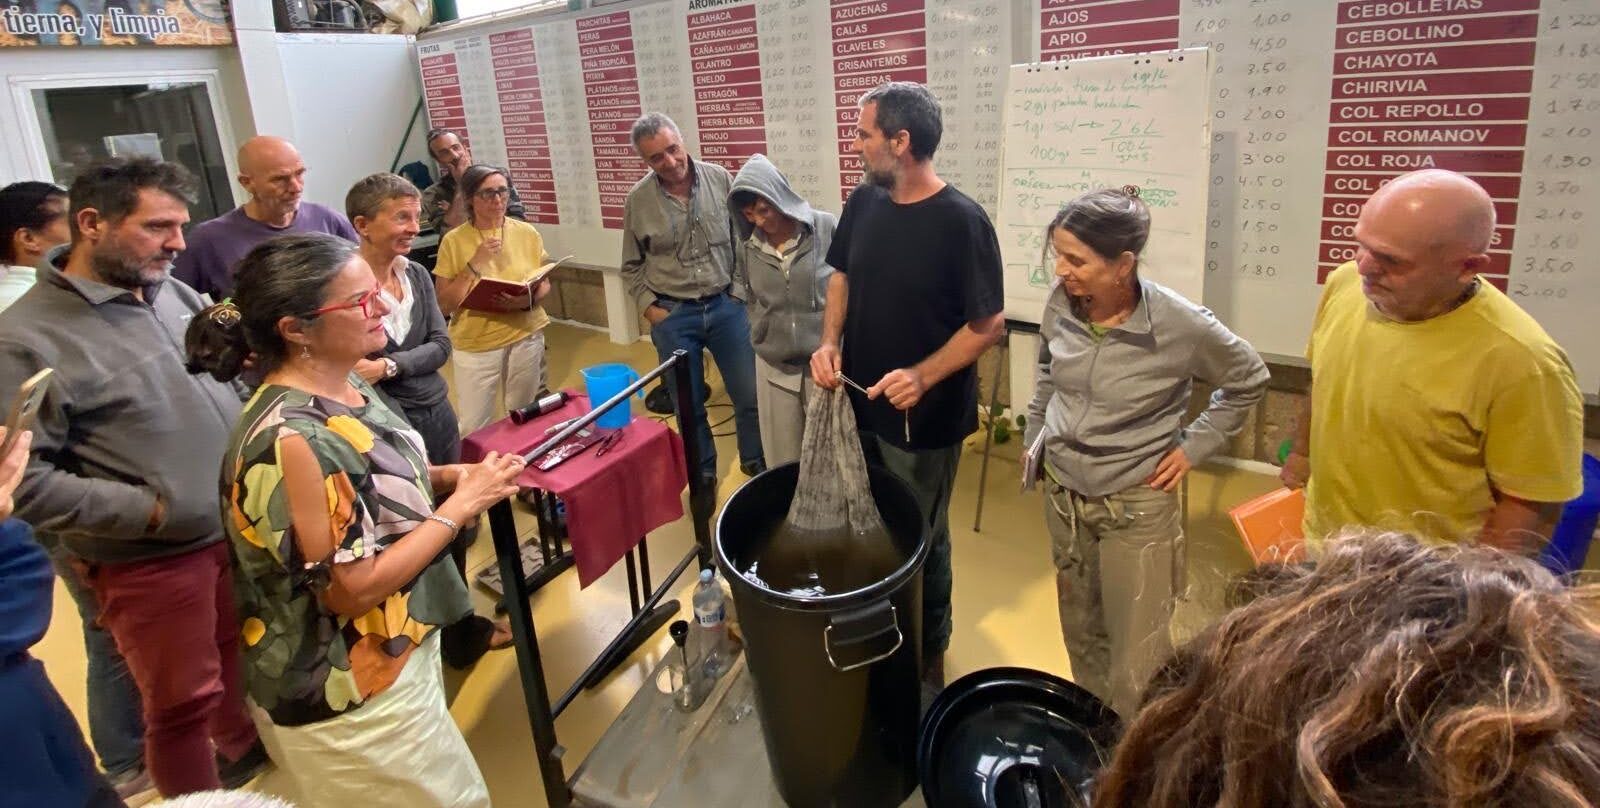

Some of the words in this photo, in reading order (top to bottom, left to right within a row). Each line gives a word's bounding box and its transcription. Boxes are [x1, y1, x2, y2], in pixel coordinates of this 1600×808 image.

[835, 3, 888, 19] AZUCENAS
[1347, 0, 1484, 20] CEBOLLETAS
[3, 5, 86, 36] tierna,
[89, 14, 103, 40] y
[109, 7, 182, 40] limpia
[578, 17, 611, 27] PARCHITAS
[690, 11, 732, 25] ALBAHACA
[1048, 10, 1089, 26] AJOS
[692, 28, 727, 41] AZAFRÁN
[726, 26, 754, 37] CANARIO
[835, 23, 868, 36] CALAS
[1345, 23, 1465, 45] CEBOLLINO
[580, 32, 600, 41] PERAS
[1048, 31, 1087, 47] APIO
[420, 44, 440, 54] FRUTAS
[582, 47, 598, 55] PERA
[598, 43, 620, 53] MELÓN
[693, 44, 714, 56] CAÑA
[836, 39, 886, 54] CLAVELES
[598, 57, 628, 67] TROPICAL
[695, 58, 732, 70] CILANTRO
[838, 54, 908, 71] CRISANTEMOS
[1343, 51, 1439, 71] CHAYOTA
[696, 74, 726, 85] ENELDO
[839, 74, 892, 88] GERBERAS
[587, 85, 618, 94] PLÁTANOS
[1341, 78, 1428, 95] CHIRIVIA
[698, 88, 738, 100] ESTRAGÓN
[589, 98, 620, 107] PLÁTANOS
[699, 103, 731, 113] HIERBAS
[591, 110, 621, 119] PLÁTANOS
[1339, 105, 1380, 120] COL
[1385, 102, 1485, 119] REPOLLO
[701, 118, 728, 127] HIERBA
[728, 117, 755, 126] BUENA
[702, 132, 729, 141] HINOJO
[1337, 129, 1378, 144] COL
[1383, 128, 1491, 144] ROMANOV
[595, 147, 629, 155] TAMARILLO
[703, 146, 728, 155] MENTA
[597, 160, 613, 168] UVAS
[1336, 153, 1376, 168] COL
[1381, 153, 1437, 168] ROJA
[598, 172, 614, 180] UVAS
[1333, 177, 1374, 192] COL
[1331, 202, 1361, 217] CO
[1330, 225, 1356, 239] CO
[1328, 247, 1357, 261] CO
